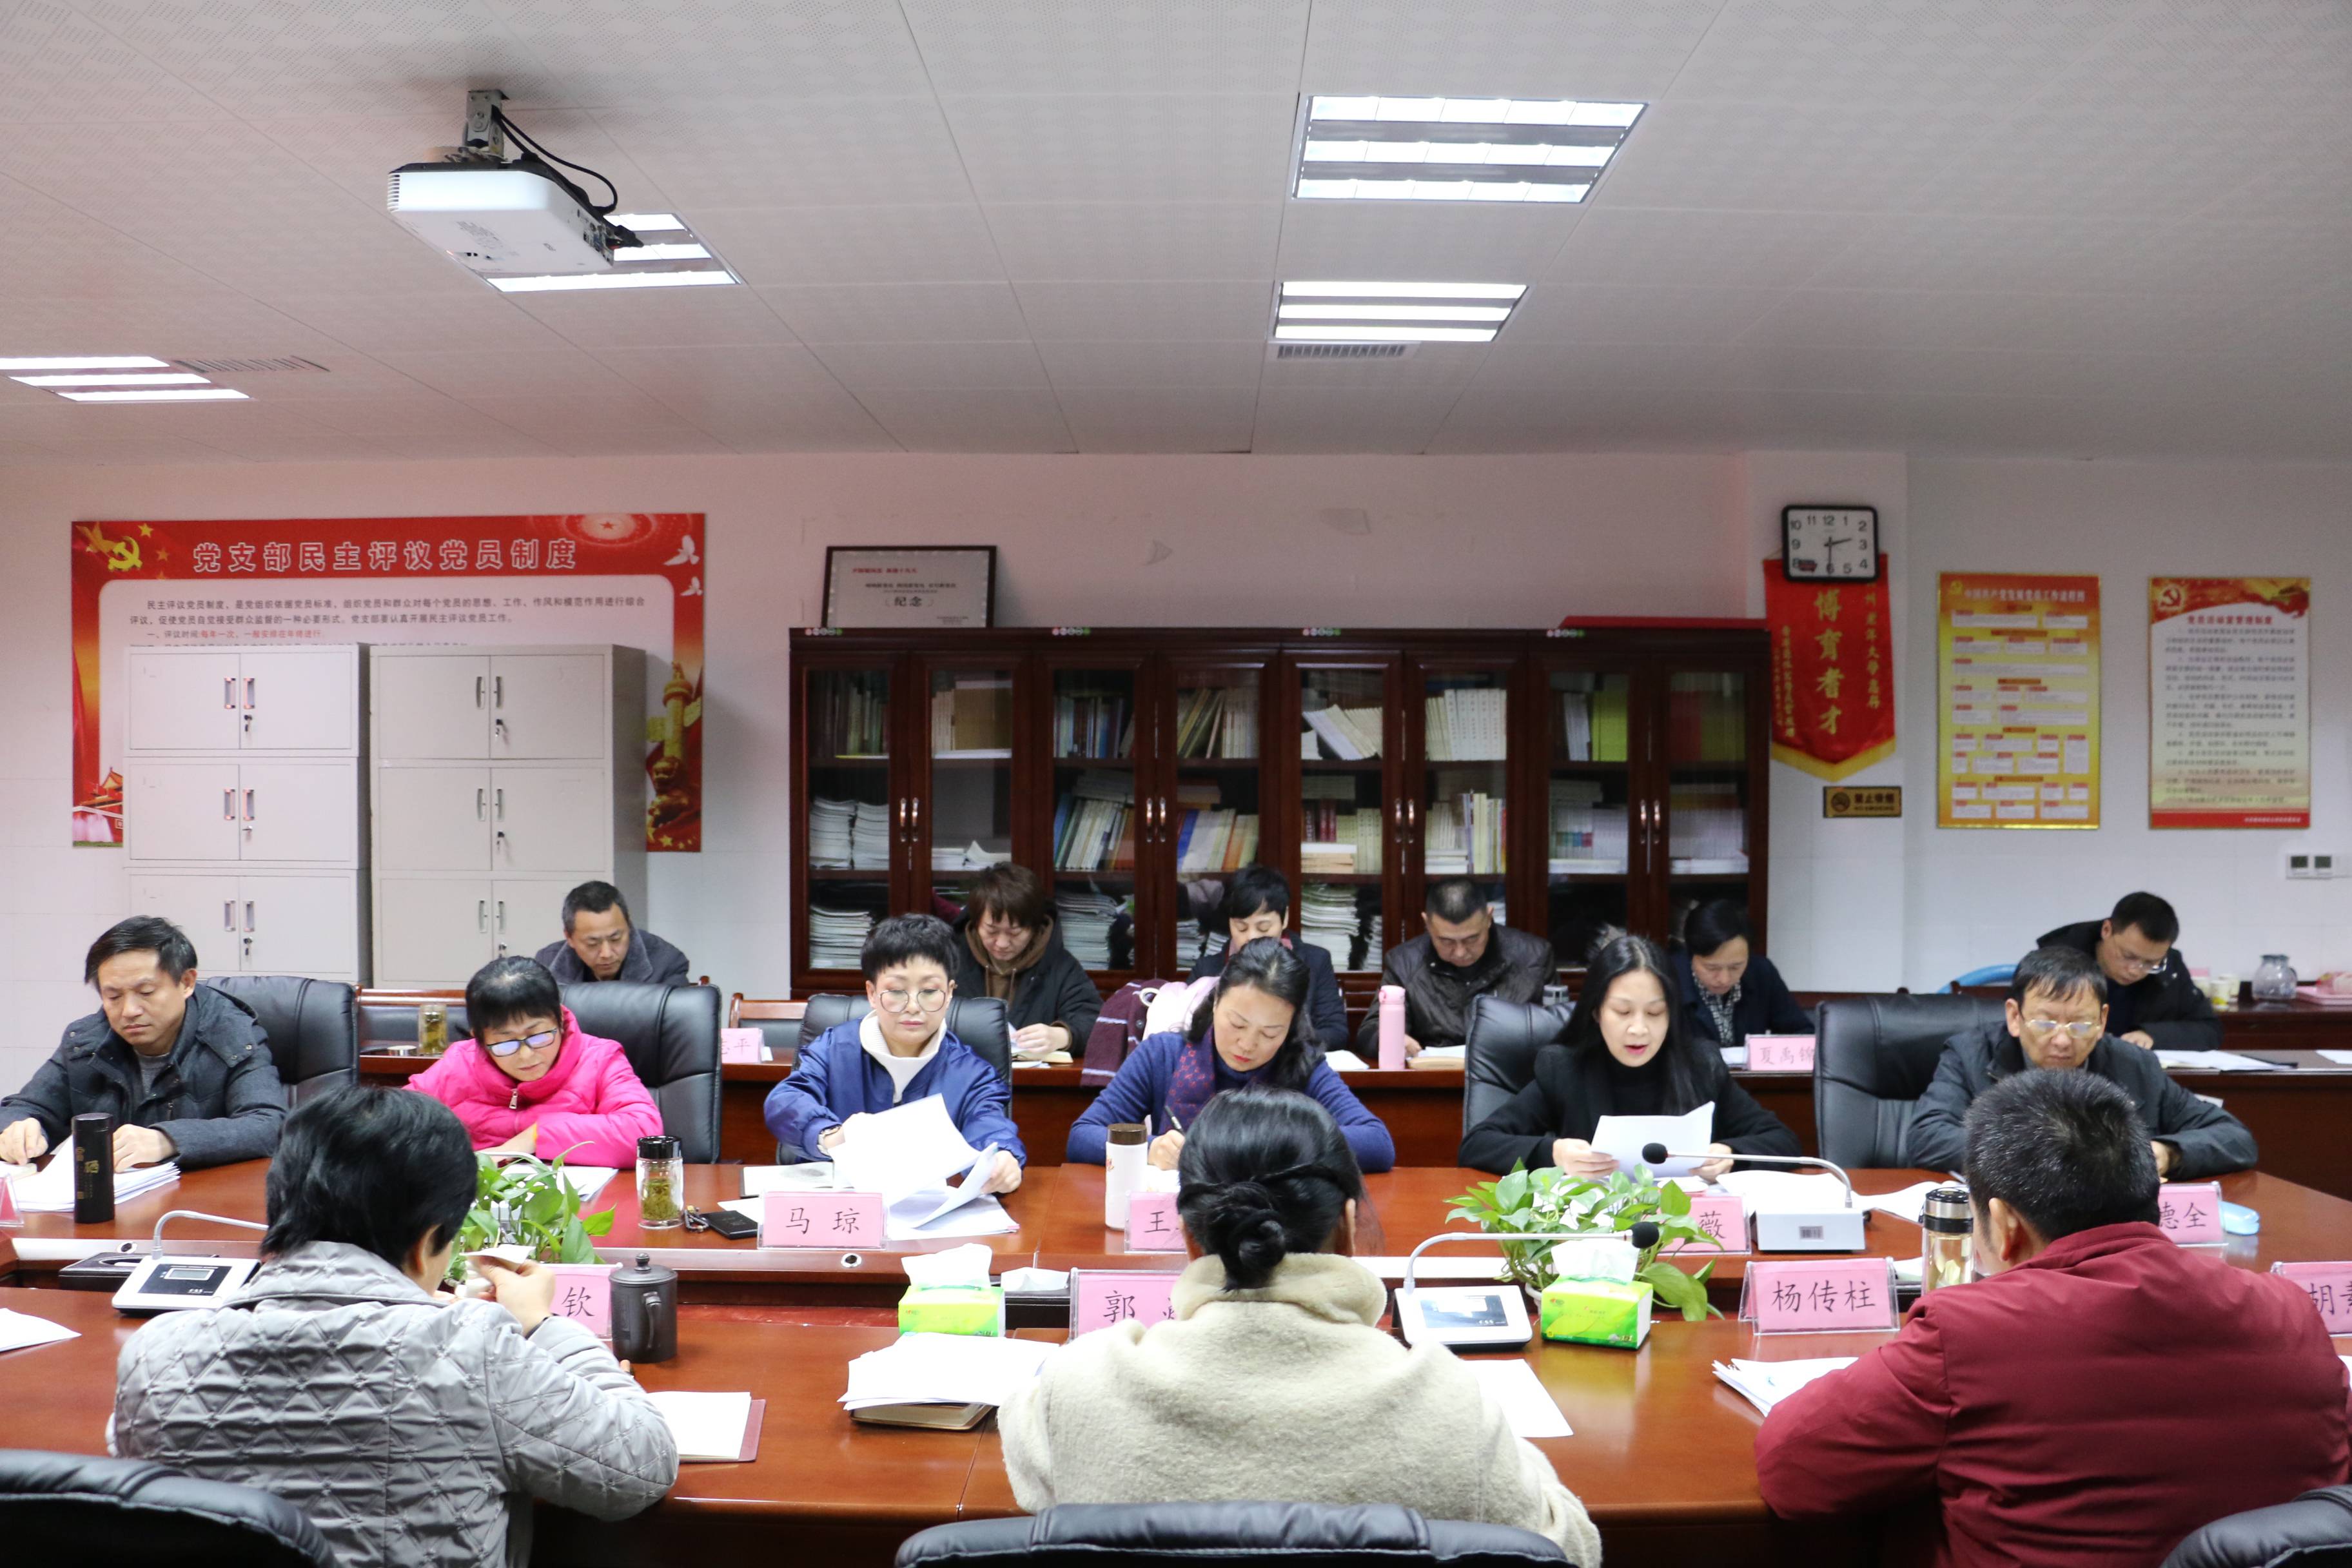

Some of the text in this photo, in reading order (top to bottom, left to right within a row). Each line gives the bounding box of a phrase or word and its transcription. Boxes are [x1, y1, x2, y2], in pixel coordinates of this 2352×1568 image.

[1790, 520, 1802, 530] 10
[1823, 515, 1835, 525] 12
[1858, 521, 1867, 532] 2
[1859, 538, 1868, 550] 3
[193, 539, 576, 572] 党支部民主评议党员制度
[1843, 563, 1852, 574] 5
[1859, 559, 1868, 569] 4
[786, 1208, 861, 1235] 马琼
[1144, 1211, 1179, 1233] 王
[1772, 1280, 1876, 1313] 杨传柱
